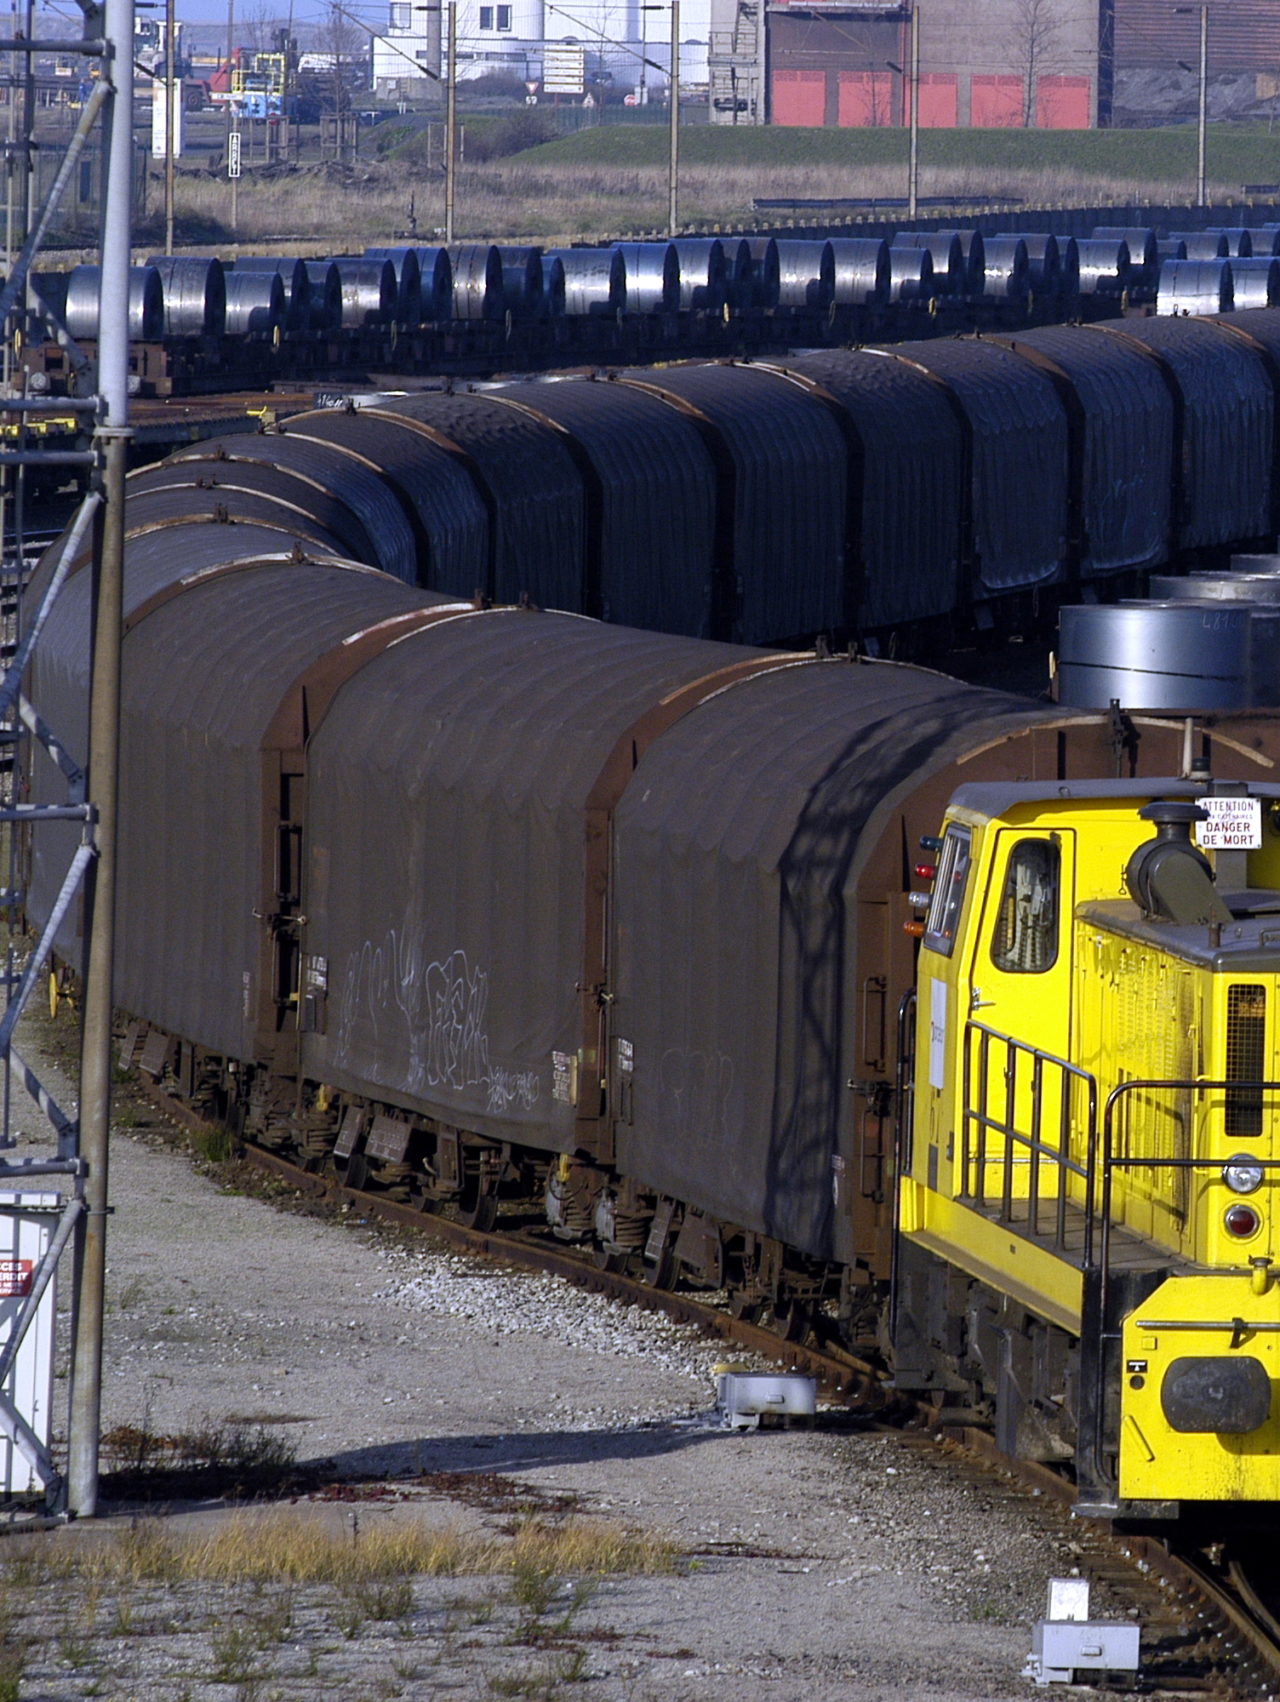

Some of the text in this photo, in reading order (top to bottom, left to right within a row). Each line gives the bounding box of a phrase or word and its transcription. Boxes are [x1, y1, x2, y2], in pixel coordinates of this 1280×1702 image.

[1203, 800, 1254, 811] ATTENTION
[1206, 822, 1250, 832] DANGER
[1203, 835, 1254, 845] DE MORT
